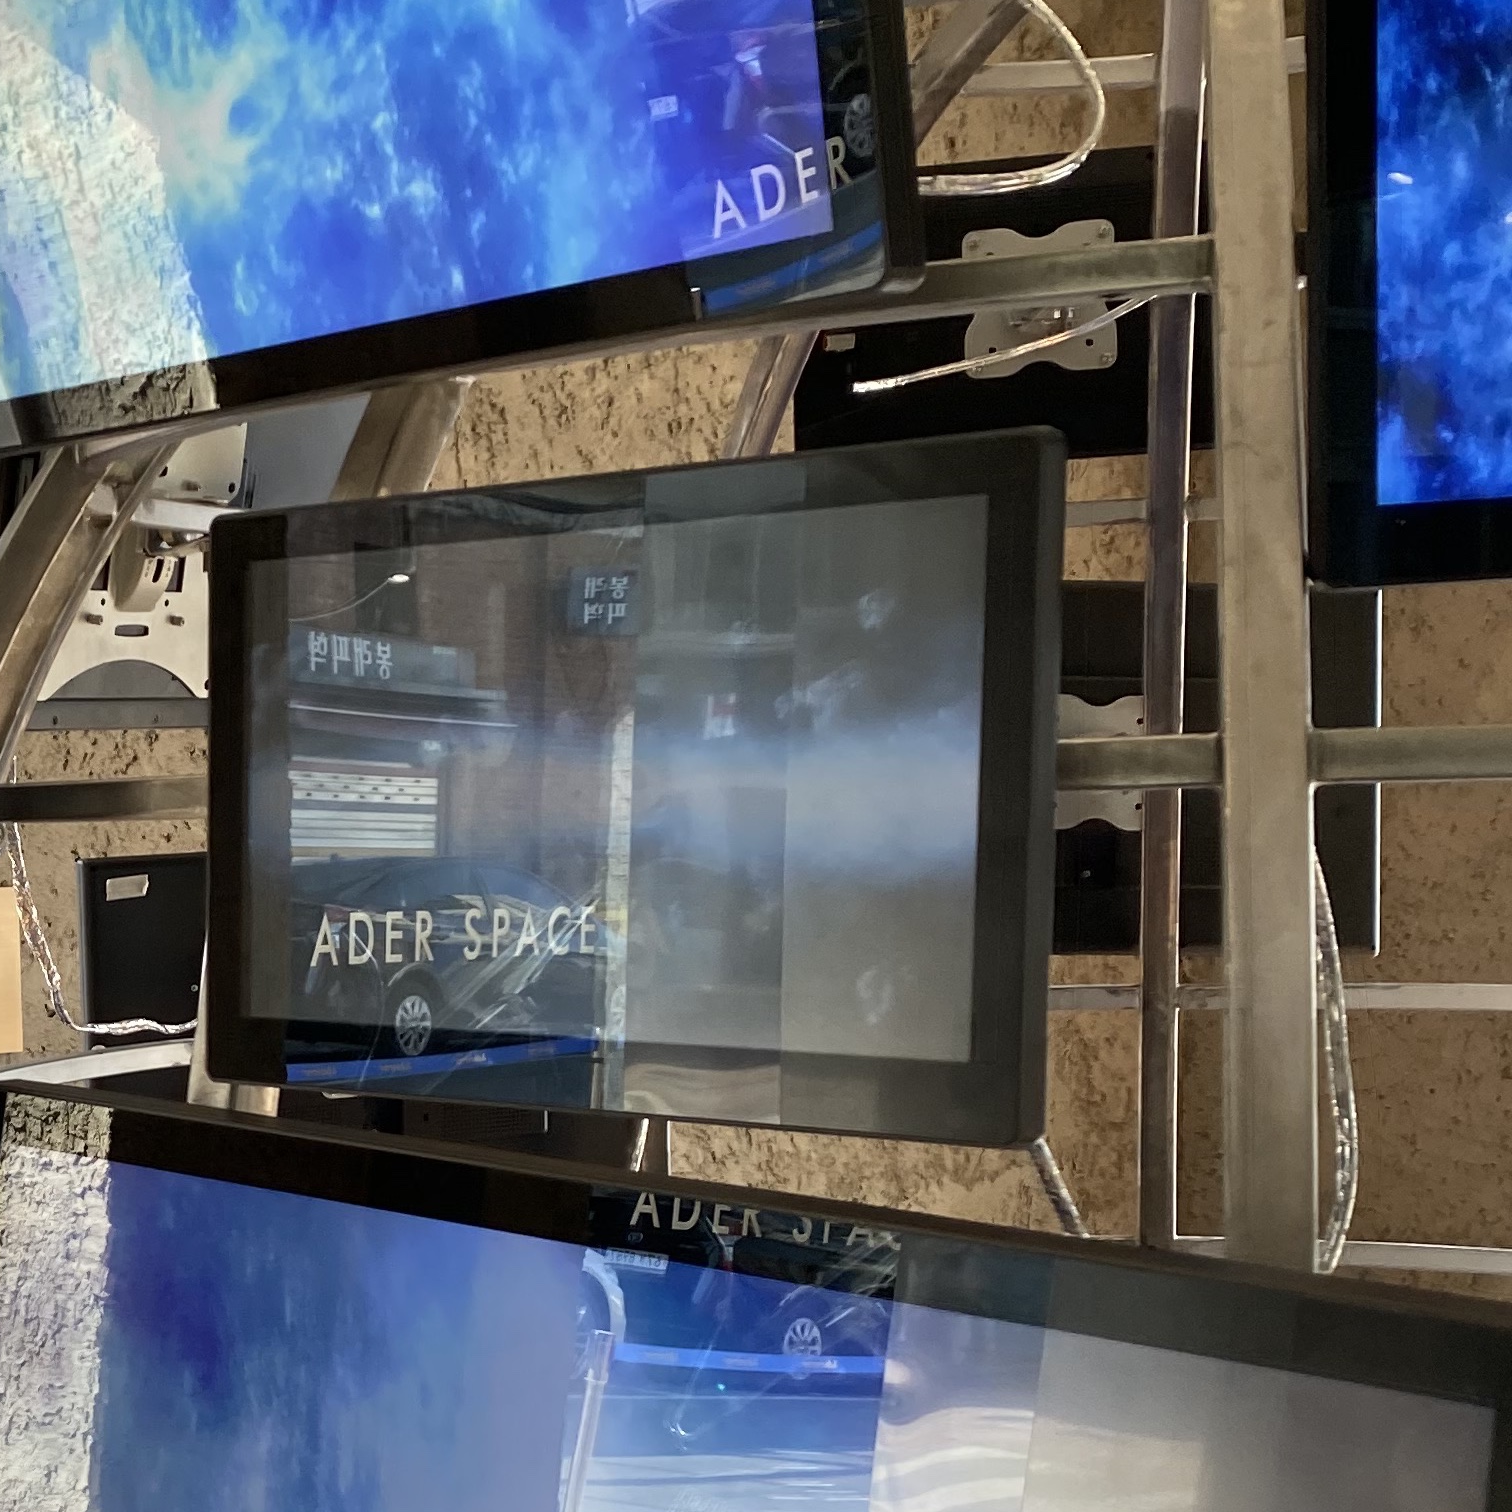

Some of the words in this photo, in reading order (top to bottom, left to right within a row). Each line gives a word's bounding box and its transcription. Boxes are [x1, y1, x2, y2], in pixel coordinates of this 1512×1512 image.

[713, 137, 851, 238] ADER
[310, 910, 434, 967] ADER
[464, 905, 597, 961] SPACE
